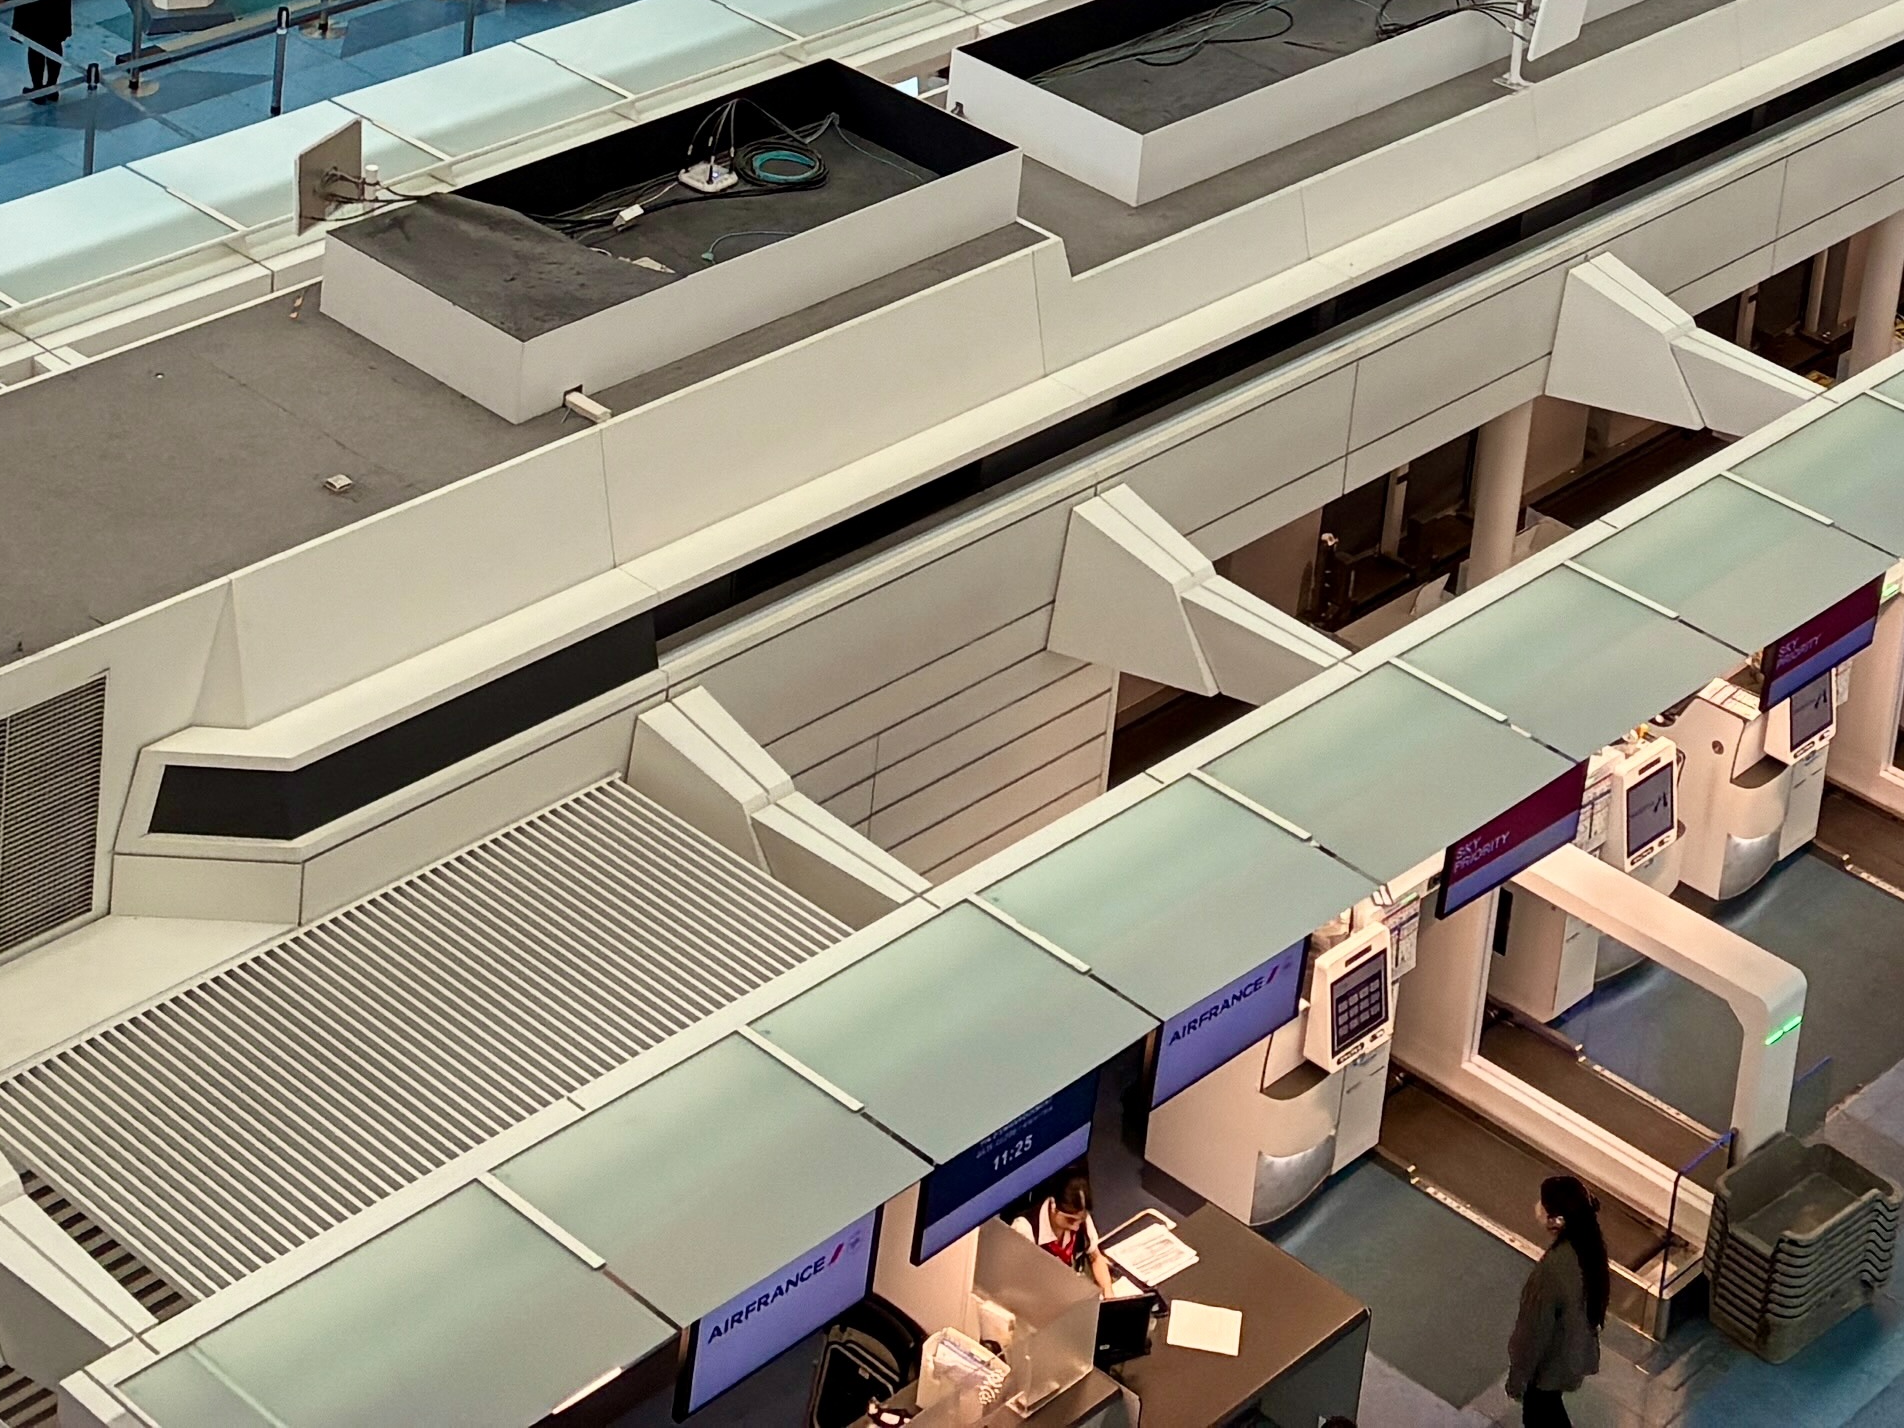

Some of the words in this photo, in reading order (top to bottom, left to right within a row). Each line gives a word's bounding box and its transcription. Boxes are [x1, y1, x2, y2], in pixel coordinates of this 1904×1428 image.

[1453, 831, 1510, 874] PRIORITY
[1455, 836, 1482, 860] SKY
[1169, 976, 1266, 1046] AIRFRANCE
[993, 1134, 1033, 1170] 11:25
[708, 1255, 827, 1344] AIRFRANCE
